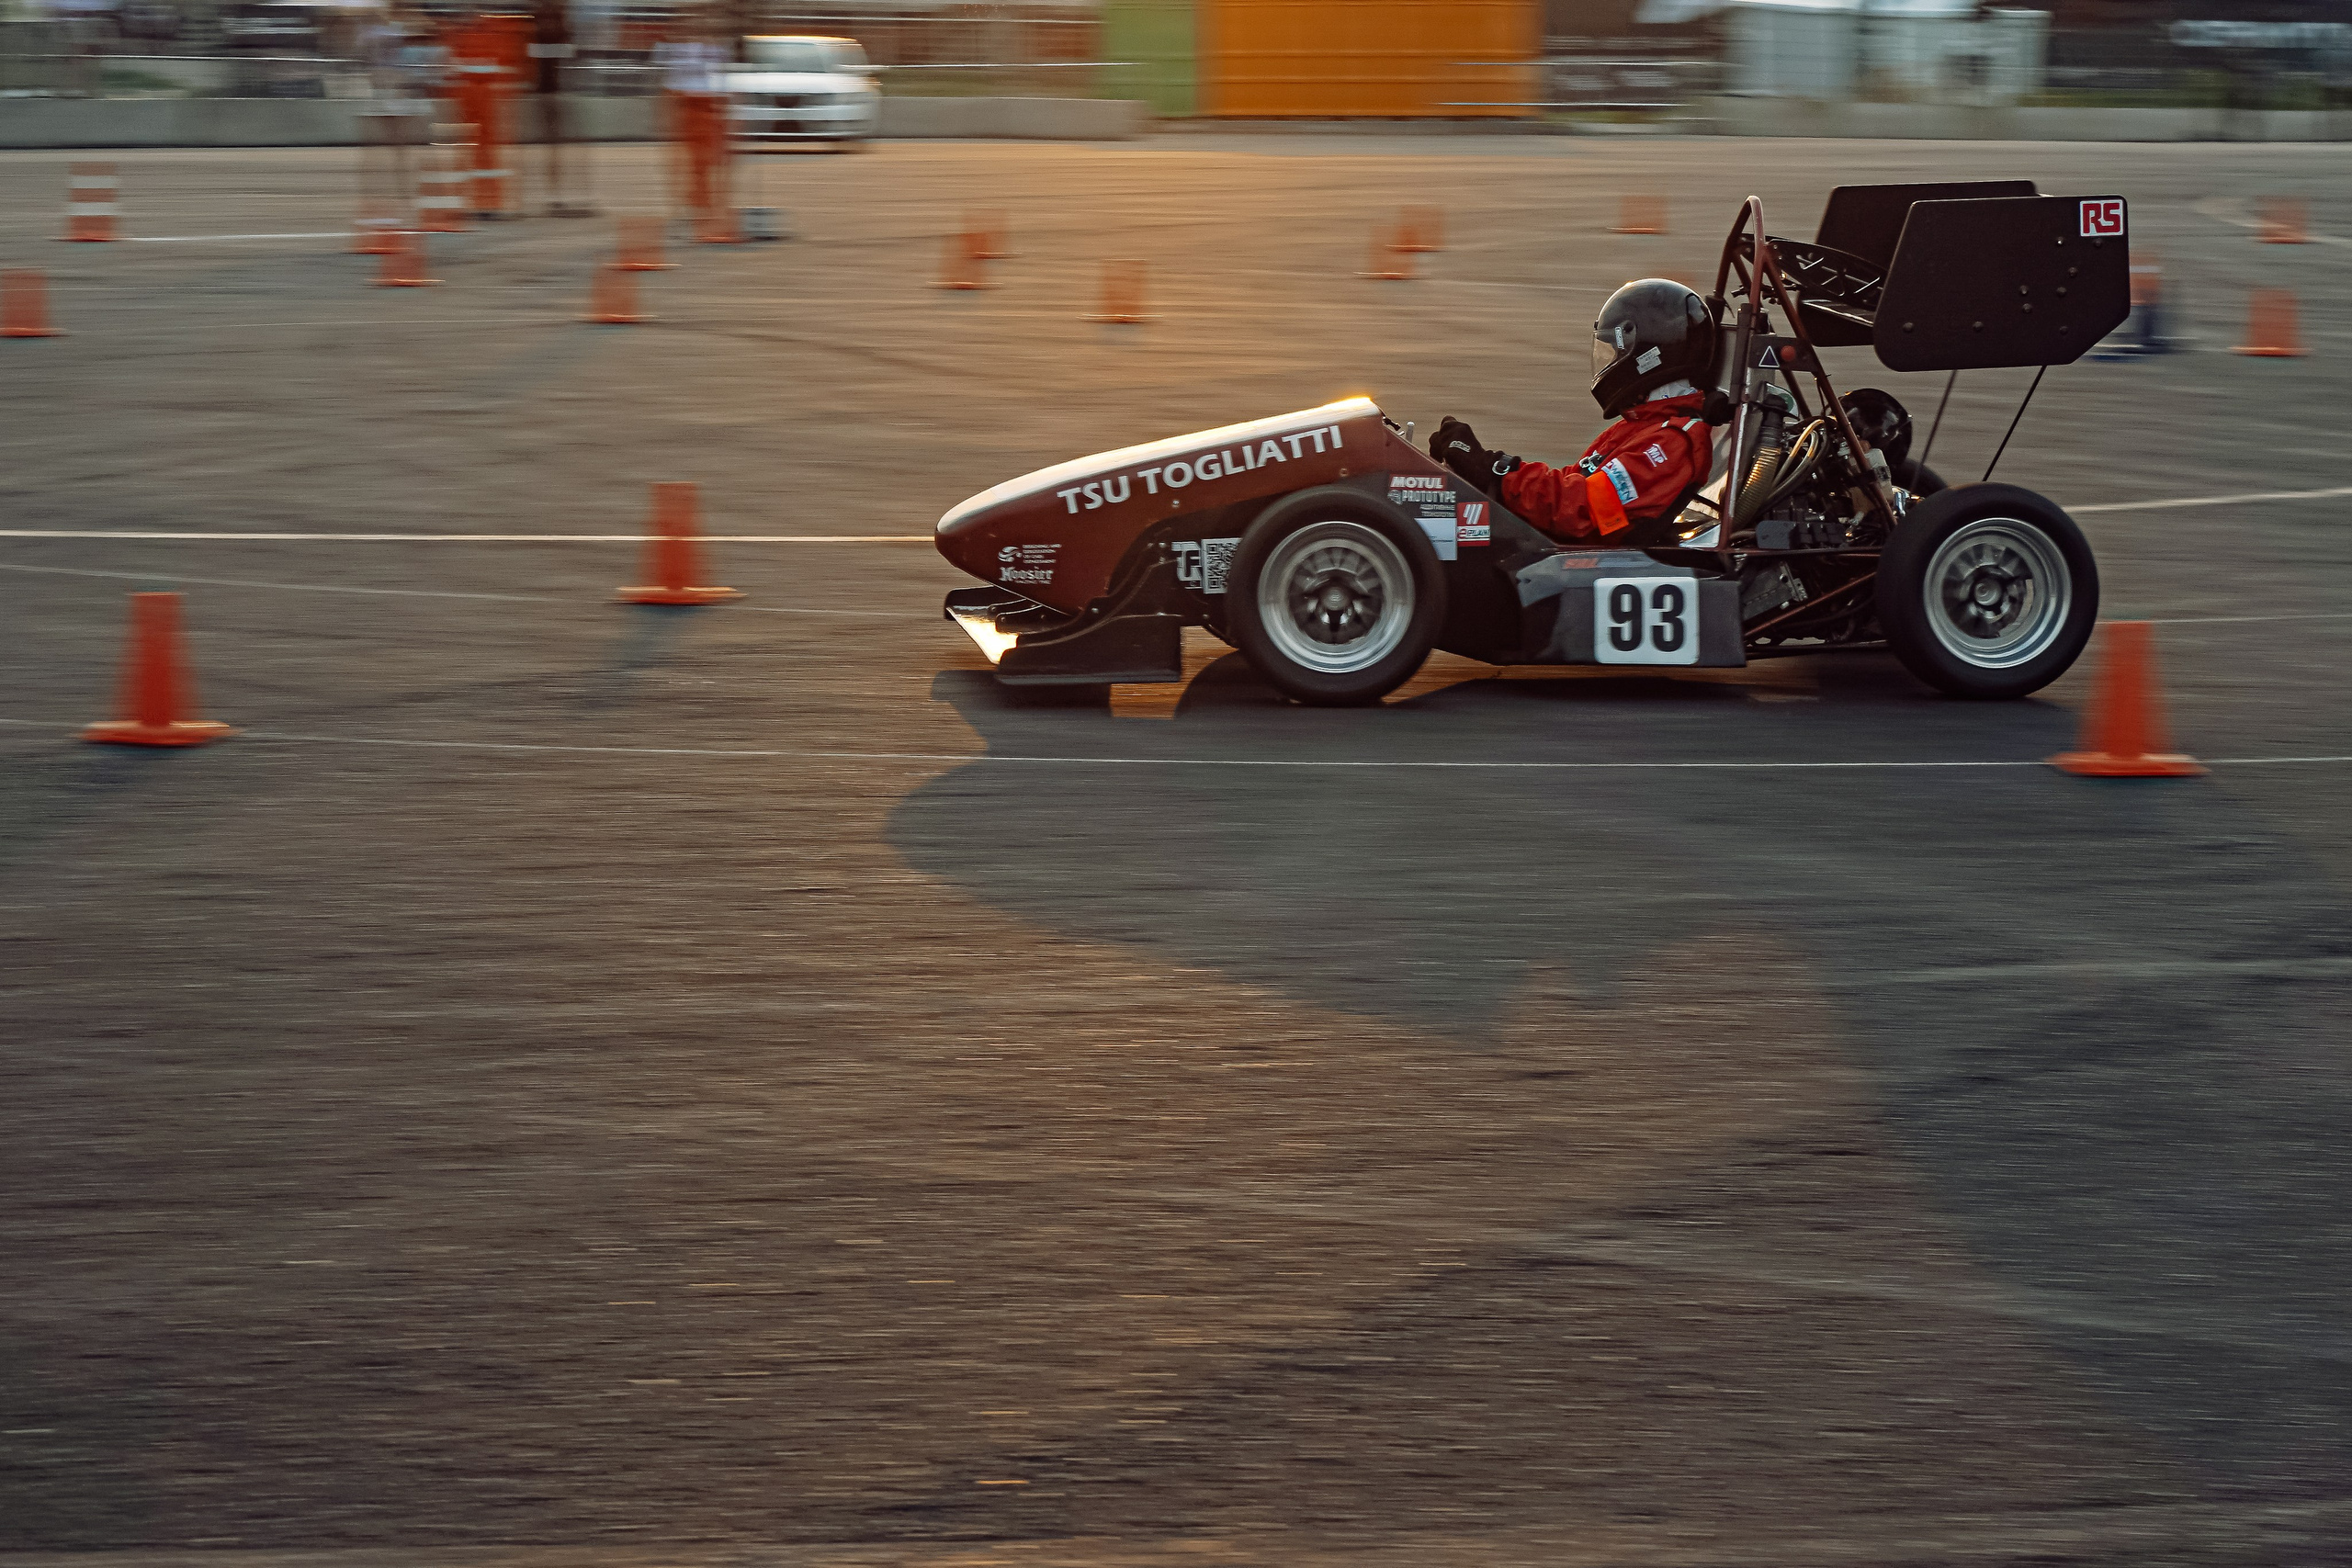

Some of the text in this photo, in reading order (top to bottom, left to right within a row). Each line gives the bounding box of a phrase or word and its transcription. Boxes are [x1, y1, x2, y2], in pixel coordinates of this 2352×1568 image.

[2082, 203, 2121, 234] RS
[1057, 425, 1343, 514] TSU TOGLIATTI
[1390, 476, 1443, 489] MOTUL
[1401, 490, 1457, 503] PROTOTYPE
[999, 566, 1054, 581] Hoosier
[1609, 583, 1685, 652] 93
